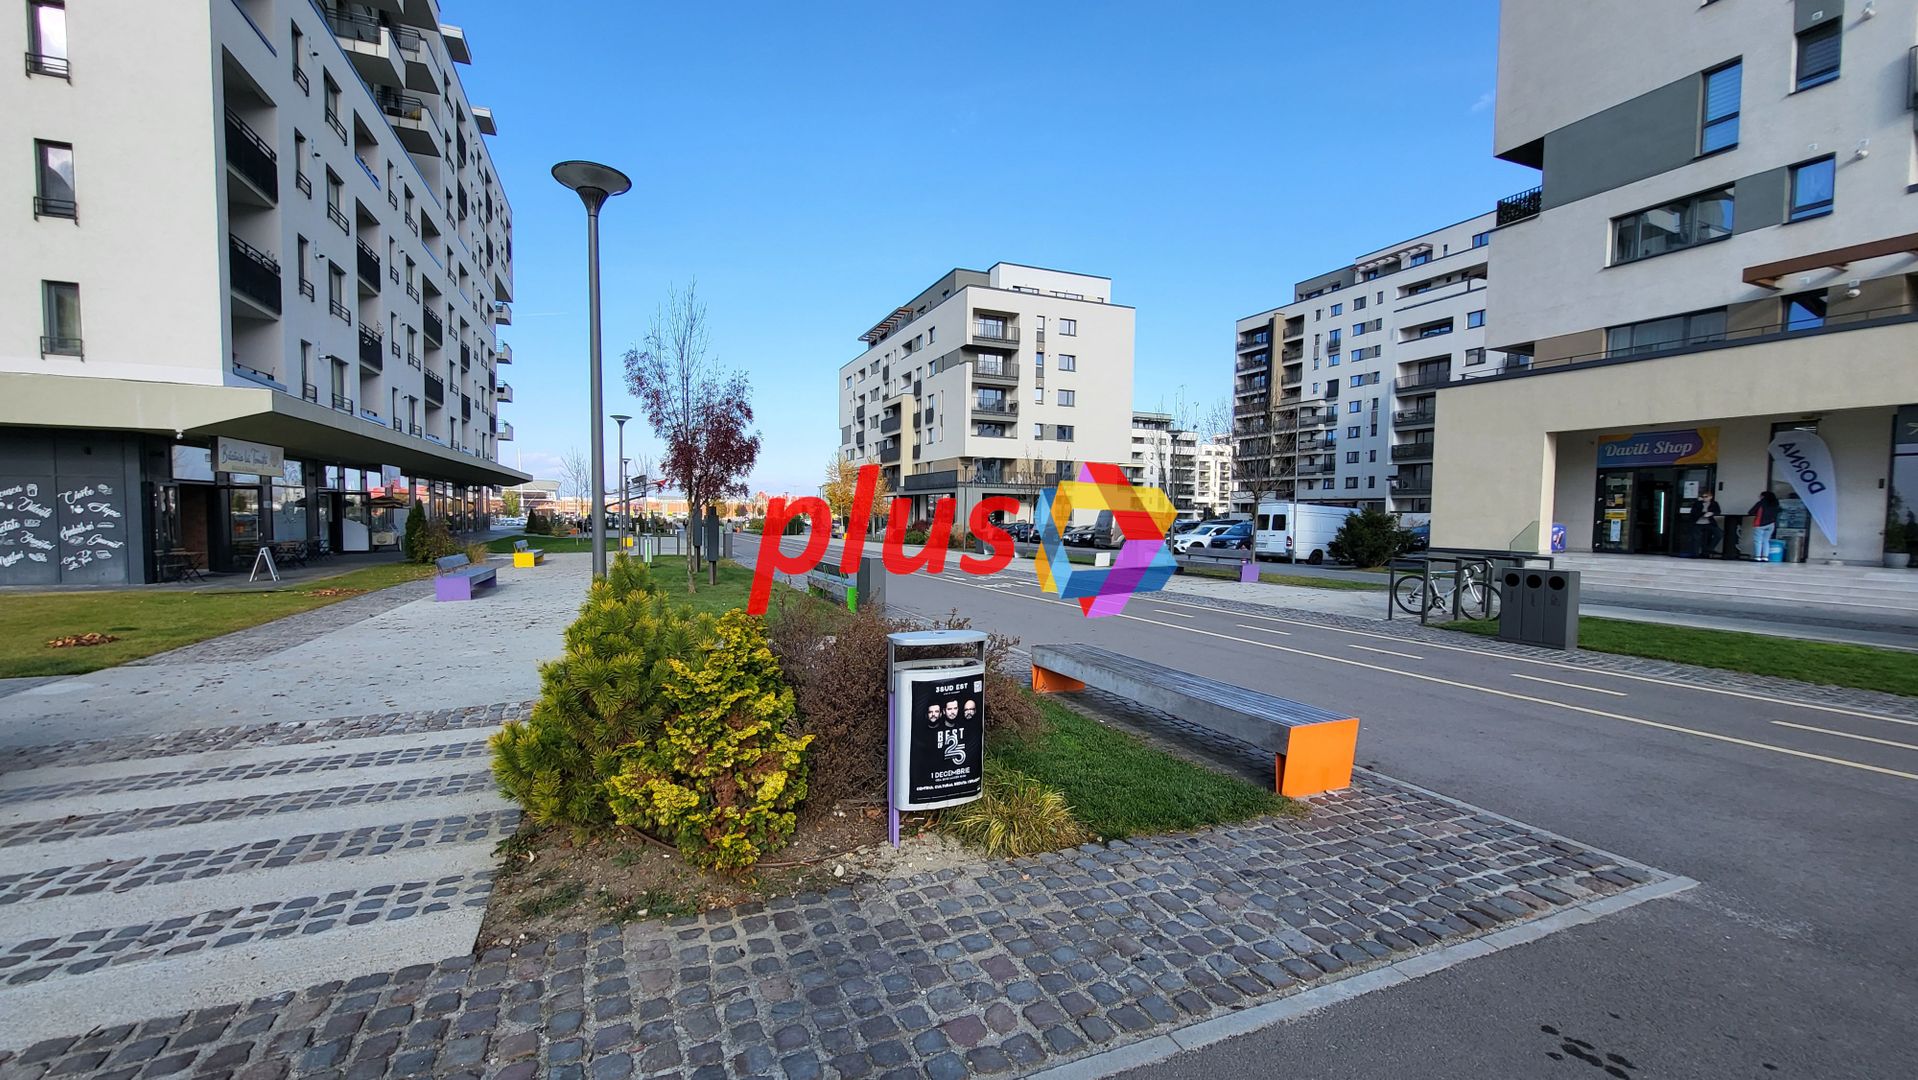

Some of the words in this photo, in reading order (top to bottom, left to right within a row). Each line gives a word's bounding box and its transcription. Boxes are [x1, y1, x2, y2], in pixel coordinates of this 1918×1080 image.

[1605, 443, 1651, 456] Davili
[1654, 441, 1692, 456] Shop
[57, 485, 95, 504] Ciorbe
[87, 502, 122, 517] Supe
[955, 682, 968, 690] EST
[937, 727, 965, 743] BEST
[944, 735, 967, 765] 25
[934, 766, 970, 779] DECEMBRIE
